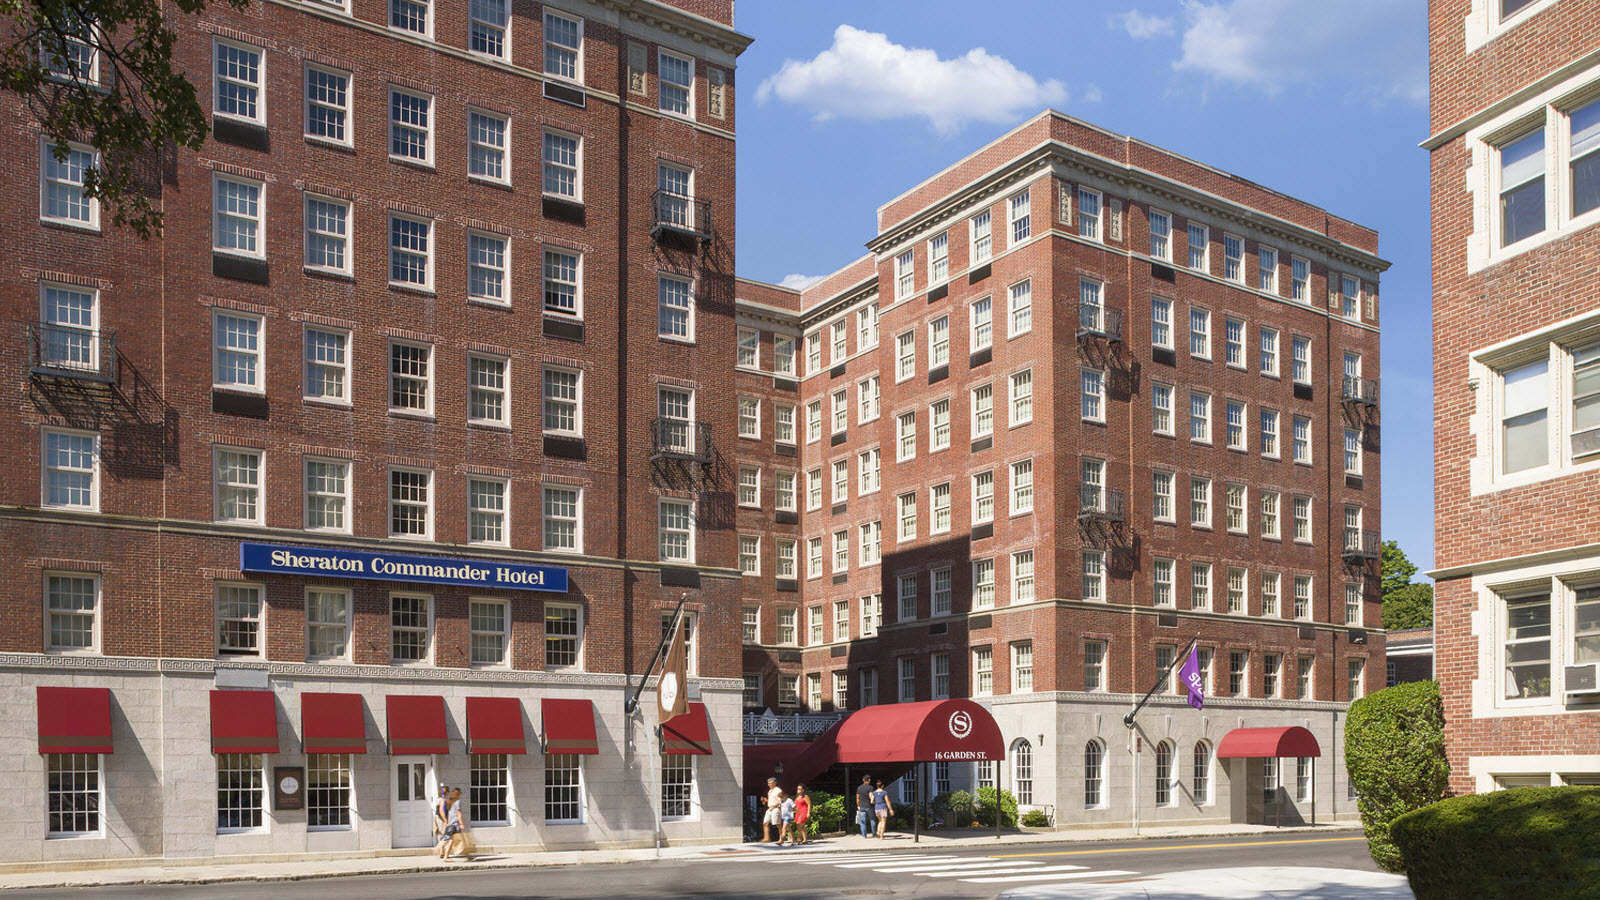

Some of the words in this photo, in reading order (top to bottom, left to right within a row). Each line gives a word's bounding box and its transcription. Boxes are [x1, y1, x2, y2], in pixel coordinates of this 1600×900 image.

[271, 550, 364, 573] Sheraton
[371, 557, 490, 581] Commander
[496, 568, 544, 585] Hotel
[953, 715, 968, 732] S
[935, 751, 942, 760] 16
[943, 751, 976, 760] GARDEN
[976, 751, 987, 760] ST.
